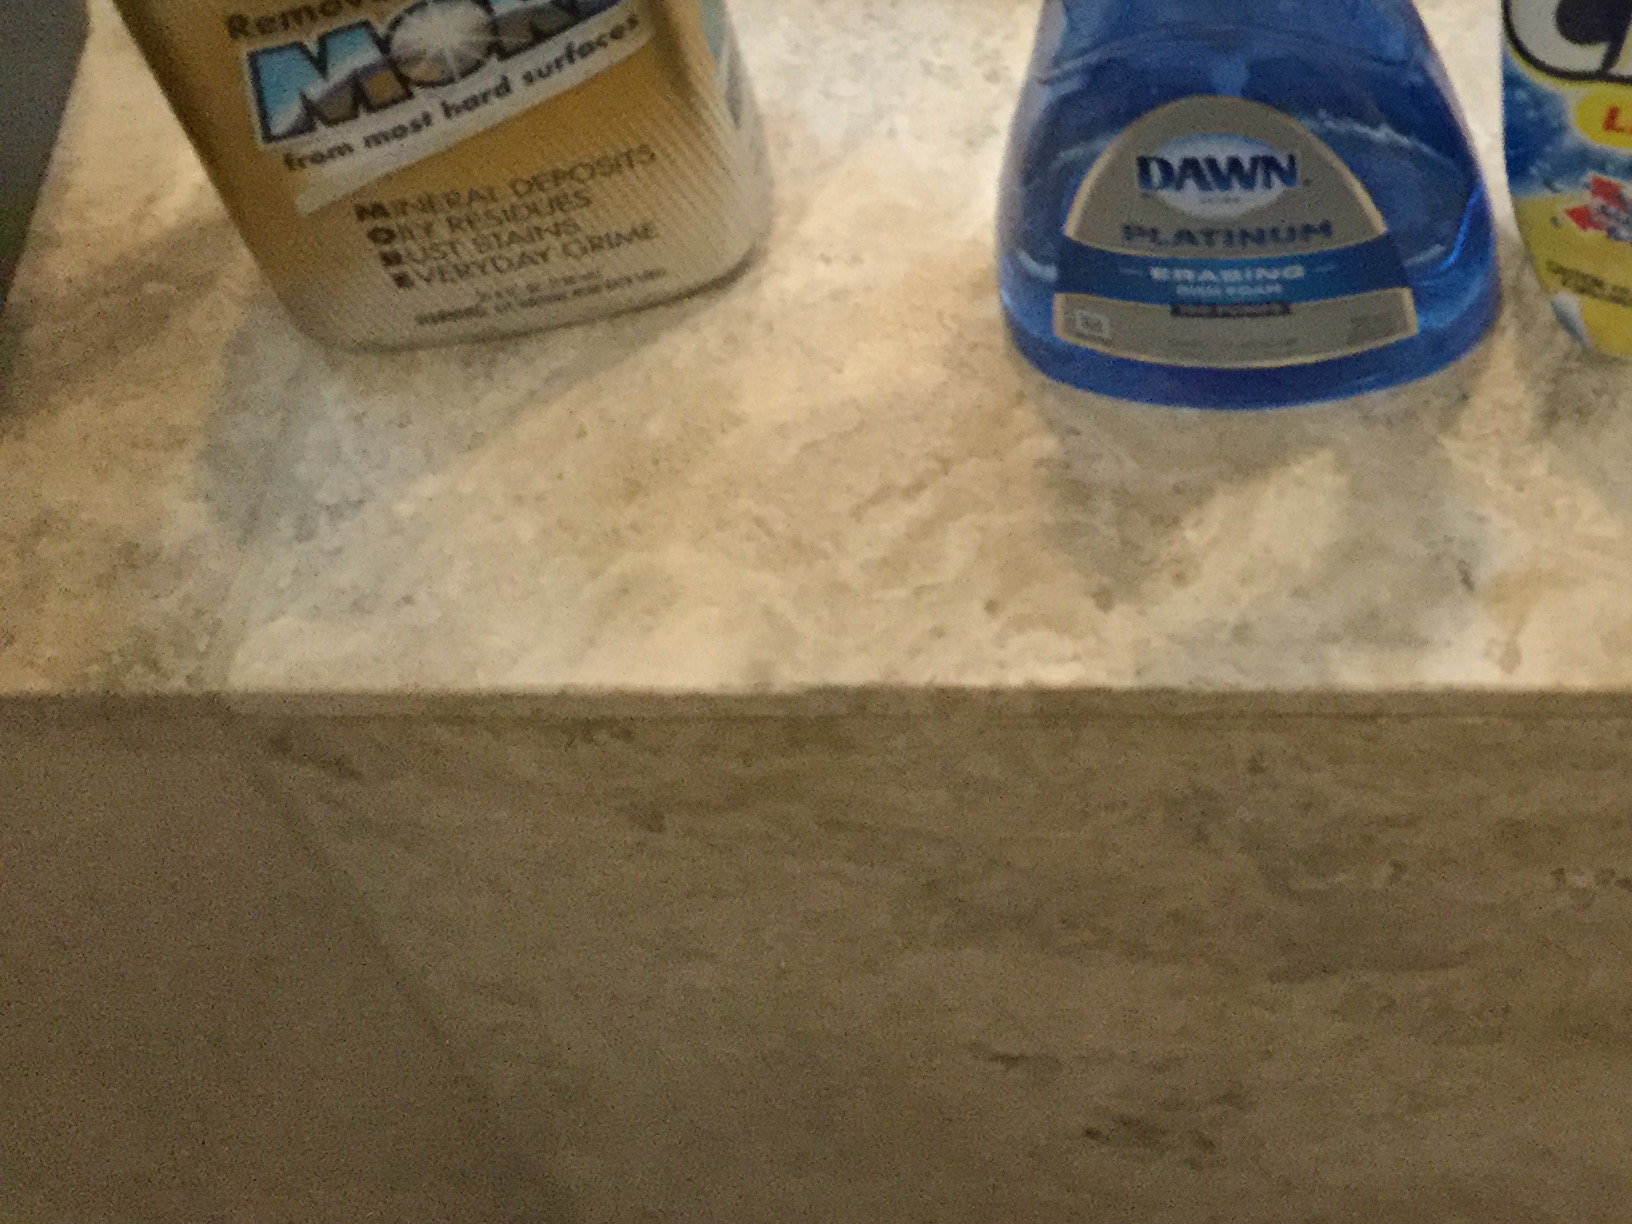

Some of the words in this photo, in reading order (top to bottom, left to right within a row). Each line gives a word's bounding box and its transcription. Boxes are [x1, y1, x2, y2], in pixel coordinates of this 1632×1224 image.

[284, 138, 354, 172] from
[363, 108, 434, 149] most
[441, 75, 512, 120] hard
[523, 14, 642, 84] surfaces
[354, 187, 496, 222] MINERAL
[509, 143, 657, 197] DEPOSITS
[1135, 153, 1298, 191] DAWN
[561, 220, 656, 259] GRIME
[1121, 219, 1334, 247] PLATINUM
